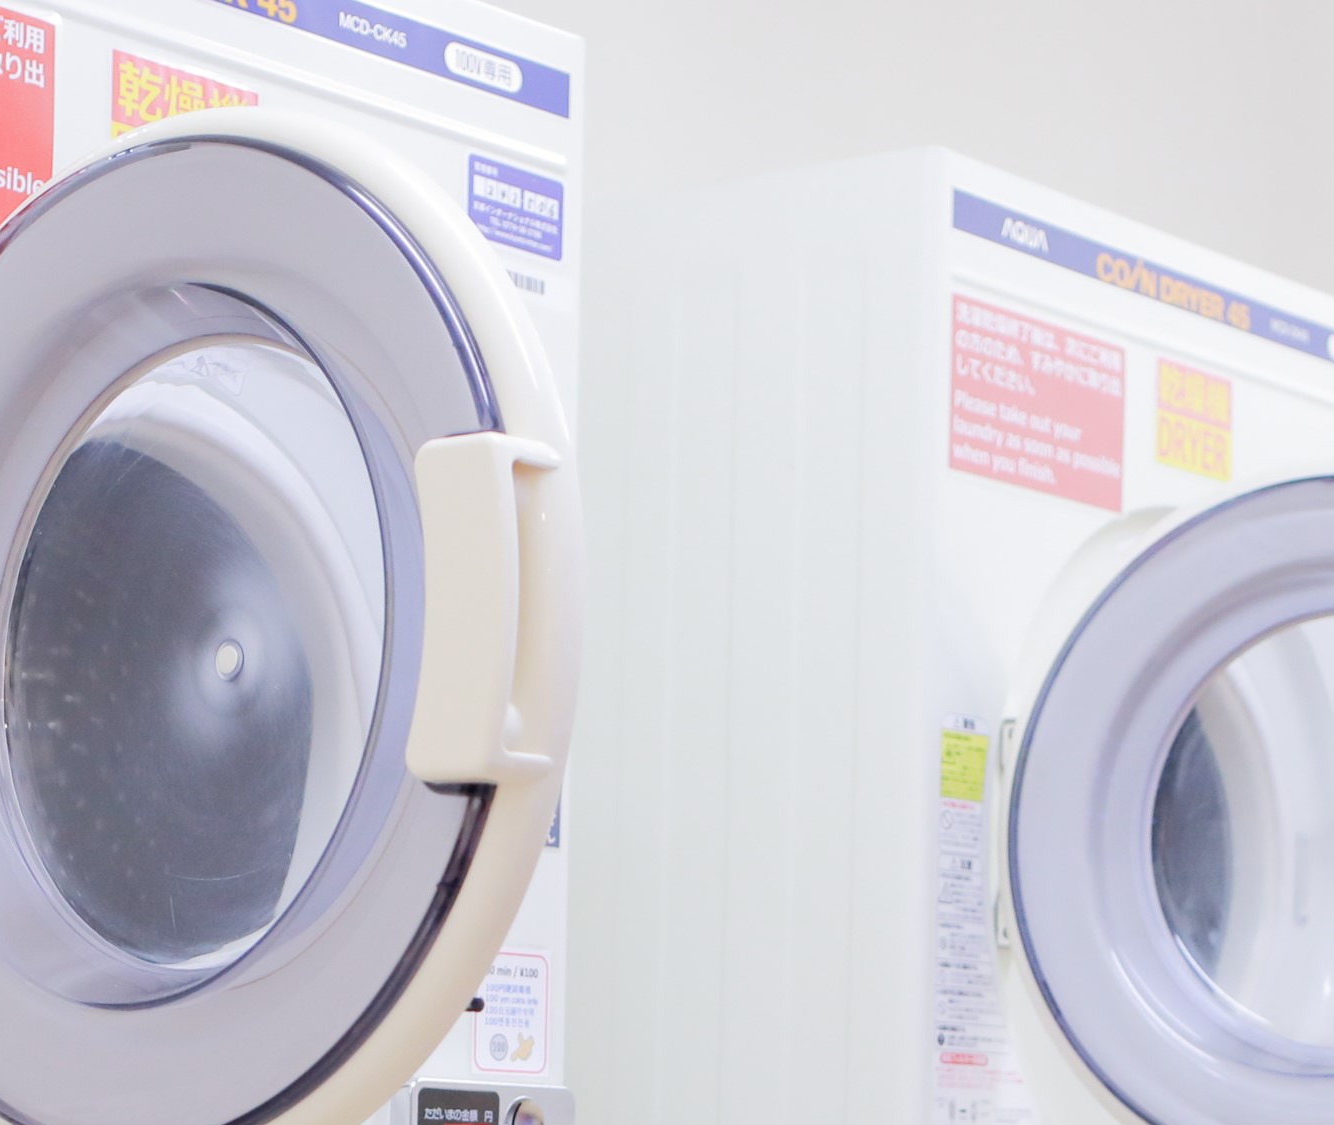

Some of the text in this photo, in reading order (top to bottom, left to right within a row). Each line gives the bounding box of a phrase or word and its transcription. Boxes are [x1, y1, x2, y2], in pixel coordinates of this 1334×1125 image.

[339, 12, 408, 48] MCD-CK45
[1001, 216, 1050, 253] AQUA
[1096, 252, 1157, 292] COIN
[1160, 275, 1224, 319] DRYER
[1227, 301, 1251, 332] 45
[954, 389, 997, 416] Please
[1160, 415, 1228, 475] DRYER
[497, 966, 511, 976] min
[484, 1110, 493, 1123] 円
